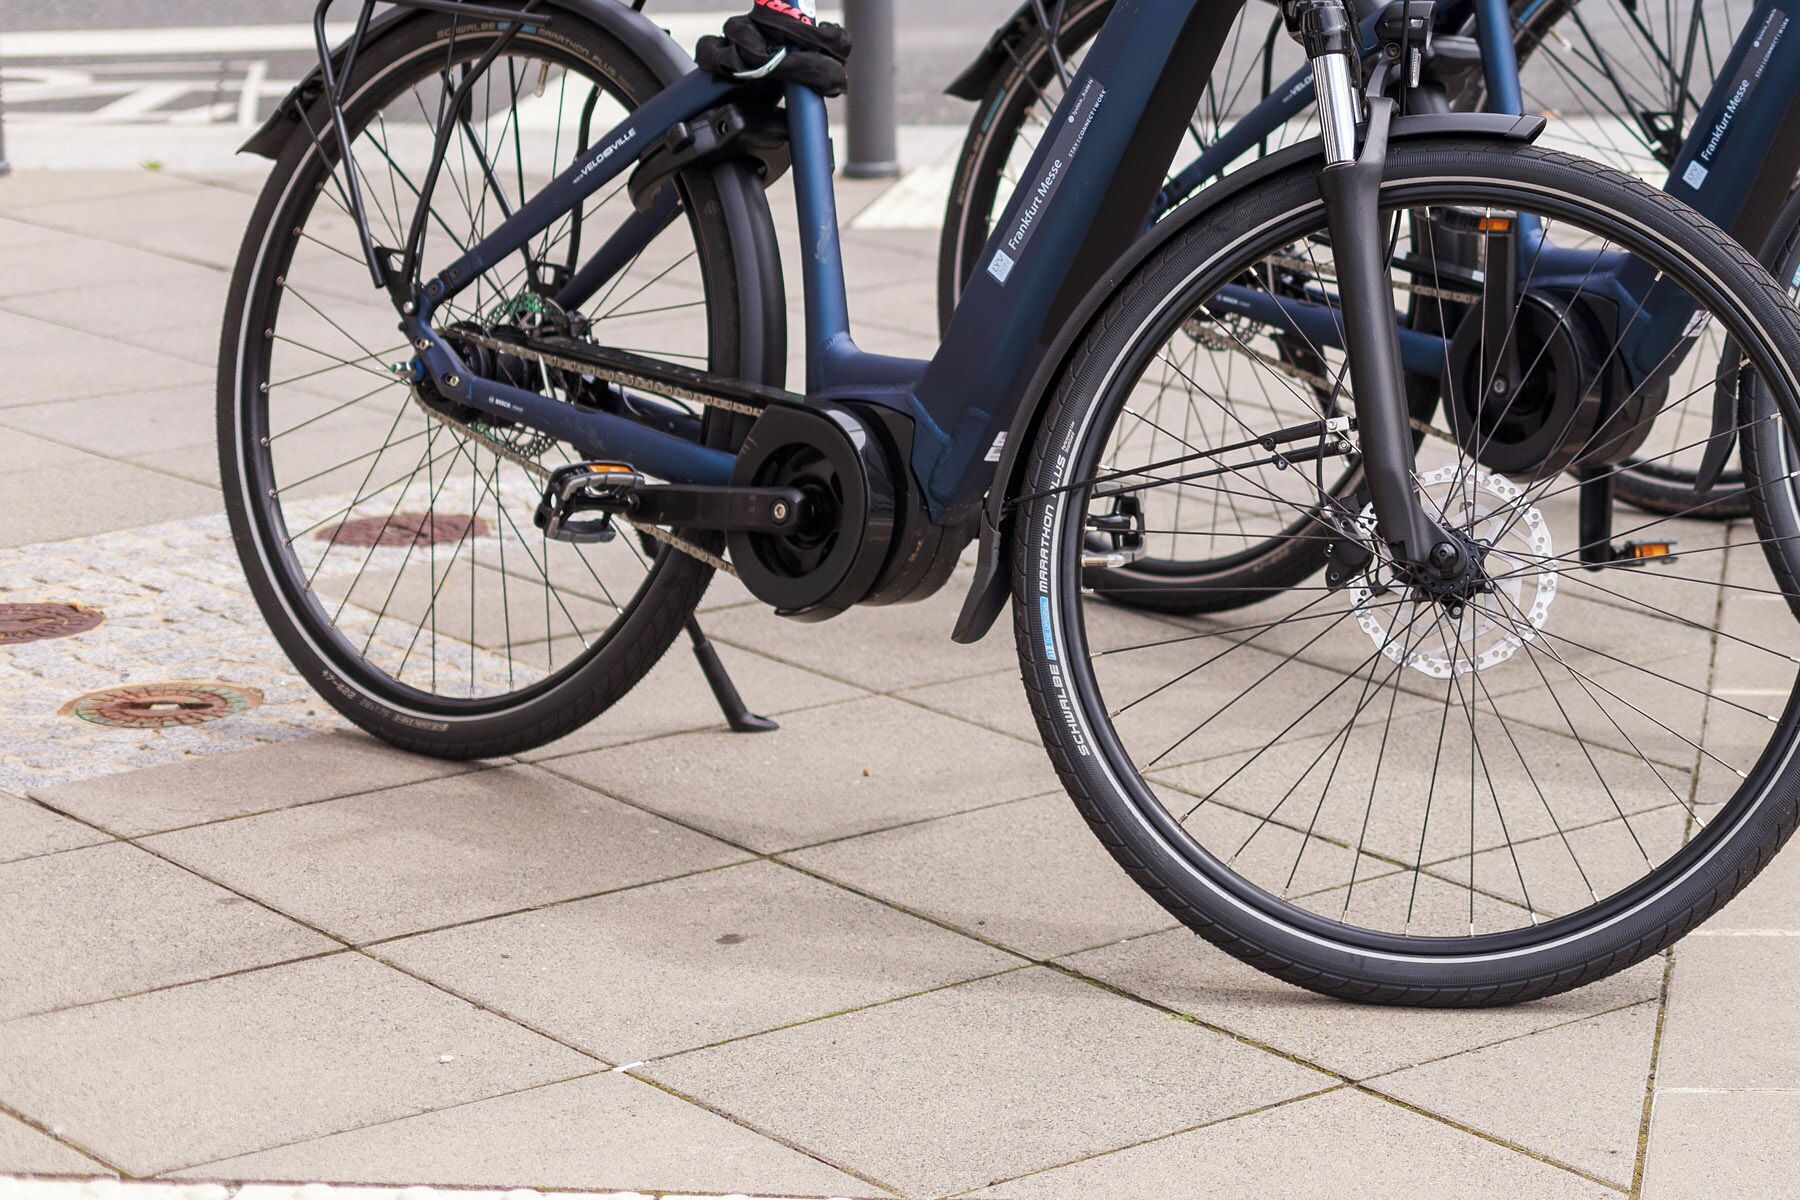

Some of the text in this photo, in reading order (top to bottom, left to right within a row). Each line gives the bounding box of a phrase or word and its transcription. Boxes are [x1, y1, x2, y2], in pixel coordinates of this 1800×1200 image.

[437, 22, 496, 39] SCWALBE
[537, 27, 590, 55] MARATHON
[1068, 89, 1107, 158] STAY CONNECT WORK
[1701, 79, 1750, 161] Frankfurt Messe
[1008, 159, 1063, 250] Frankfurt Messe
[1039, 504, 1054, 593] MARATHON
[1049, 663, 1090, 757] SCHWALBE
